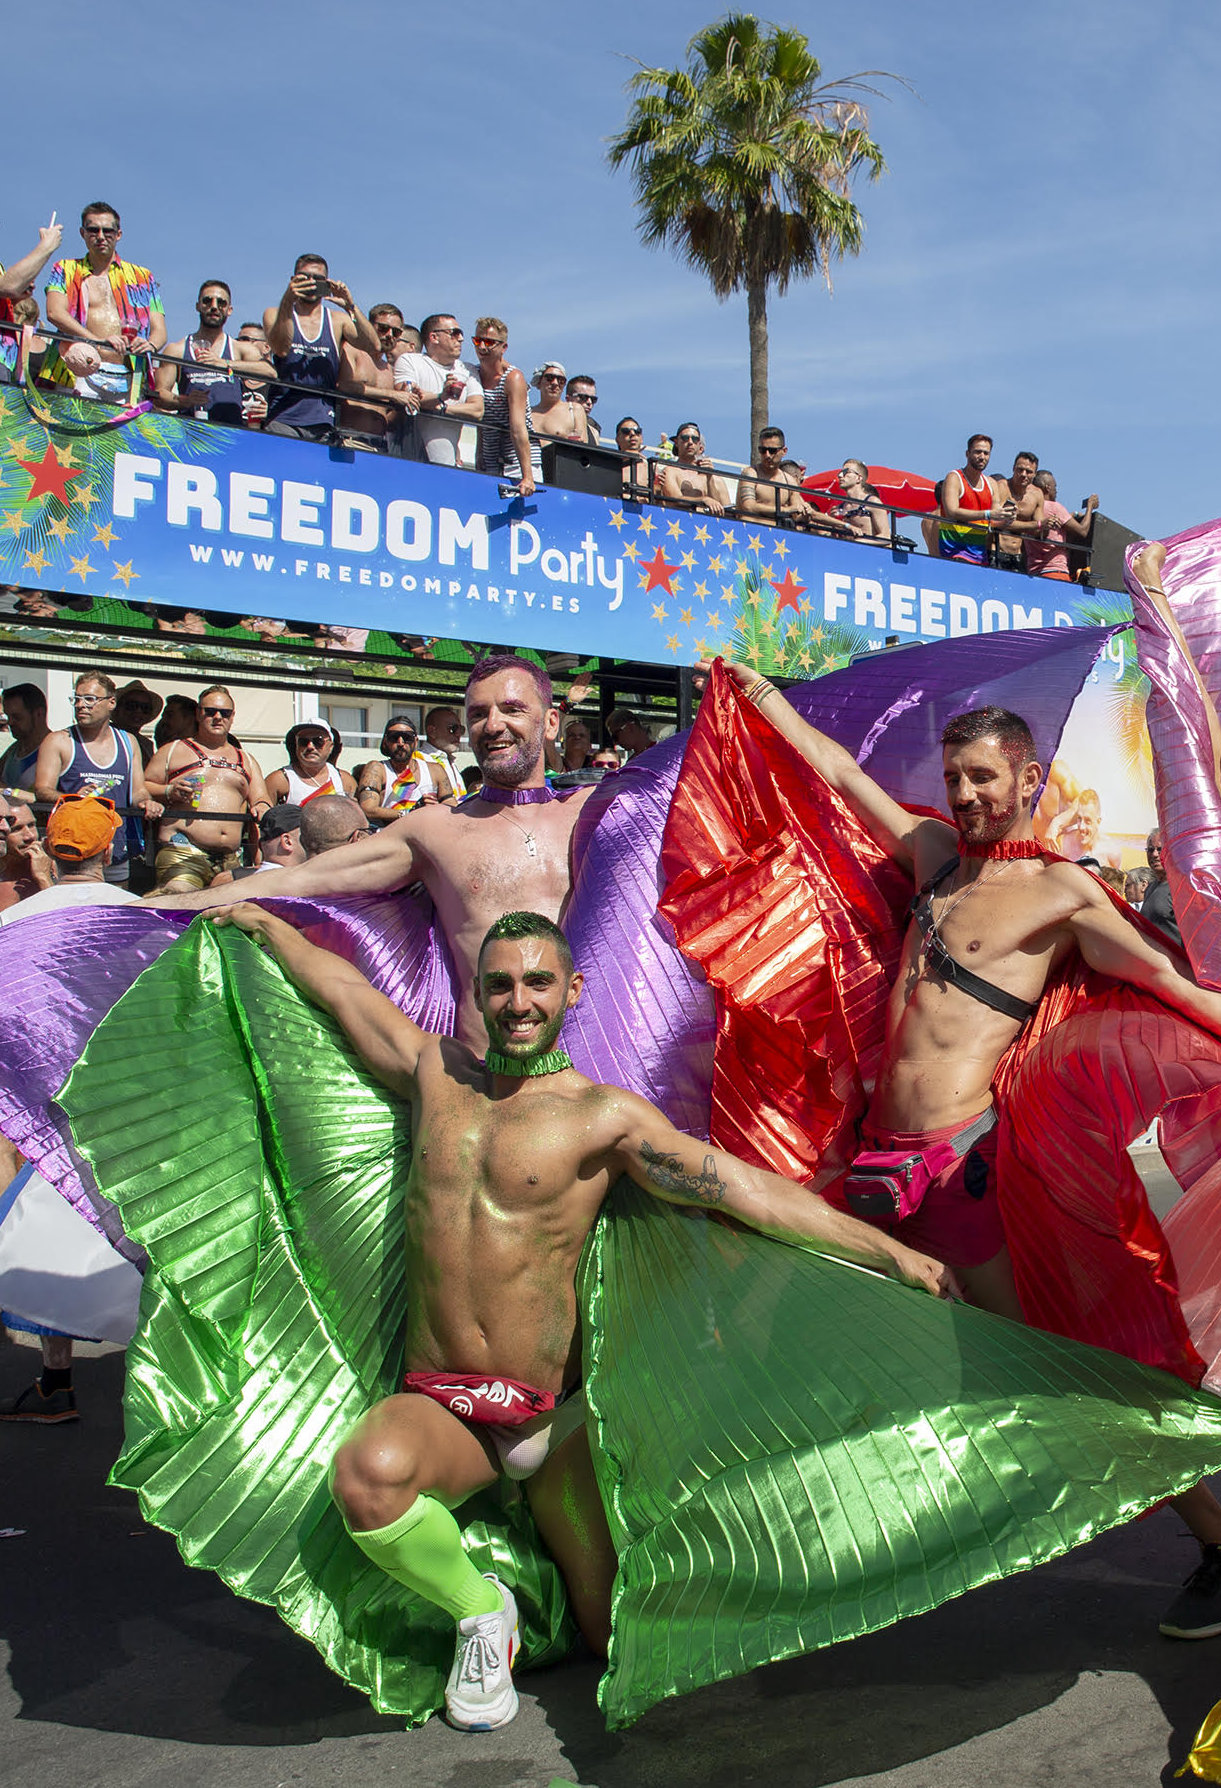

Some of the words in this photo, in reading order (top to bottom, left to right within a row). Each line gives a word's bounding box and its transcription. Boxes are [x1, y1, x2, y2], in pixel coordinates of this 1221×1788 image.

[113, 452, 490, 571] FREEDOM
[510, 518, 624, 611] Party
[189, 544, 580, 614] WWW.FREEDOMPARTY.ES
